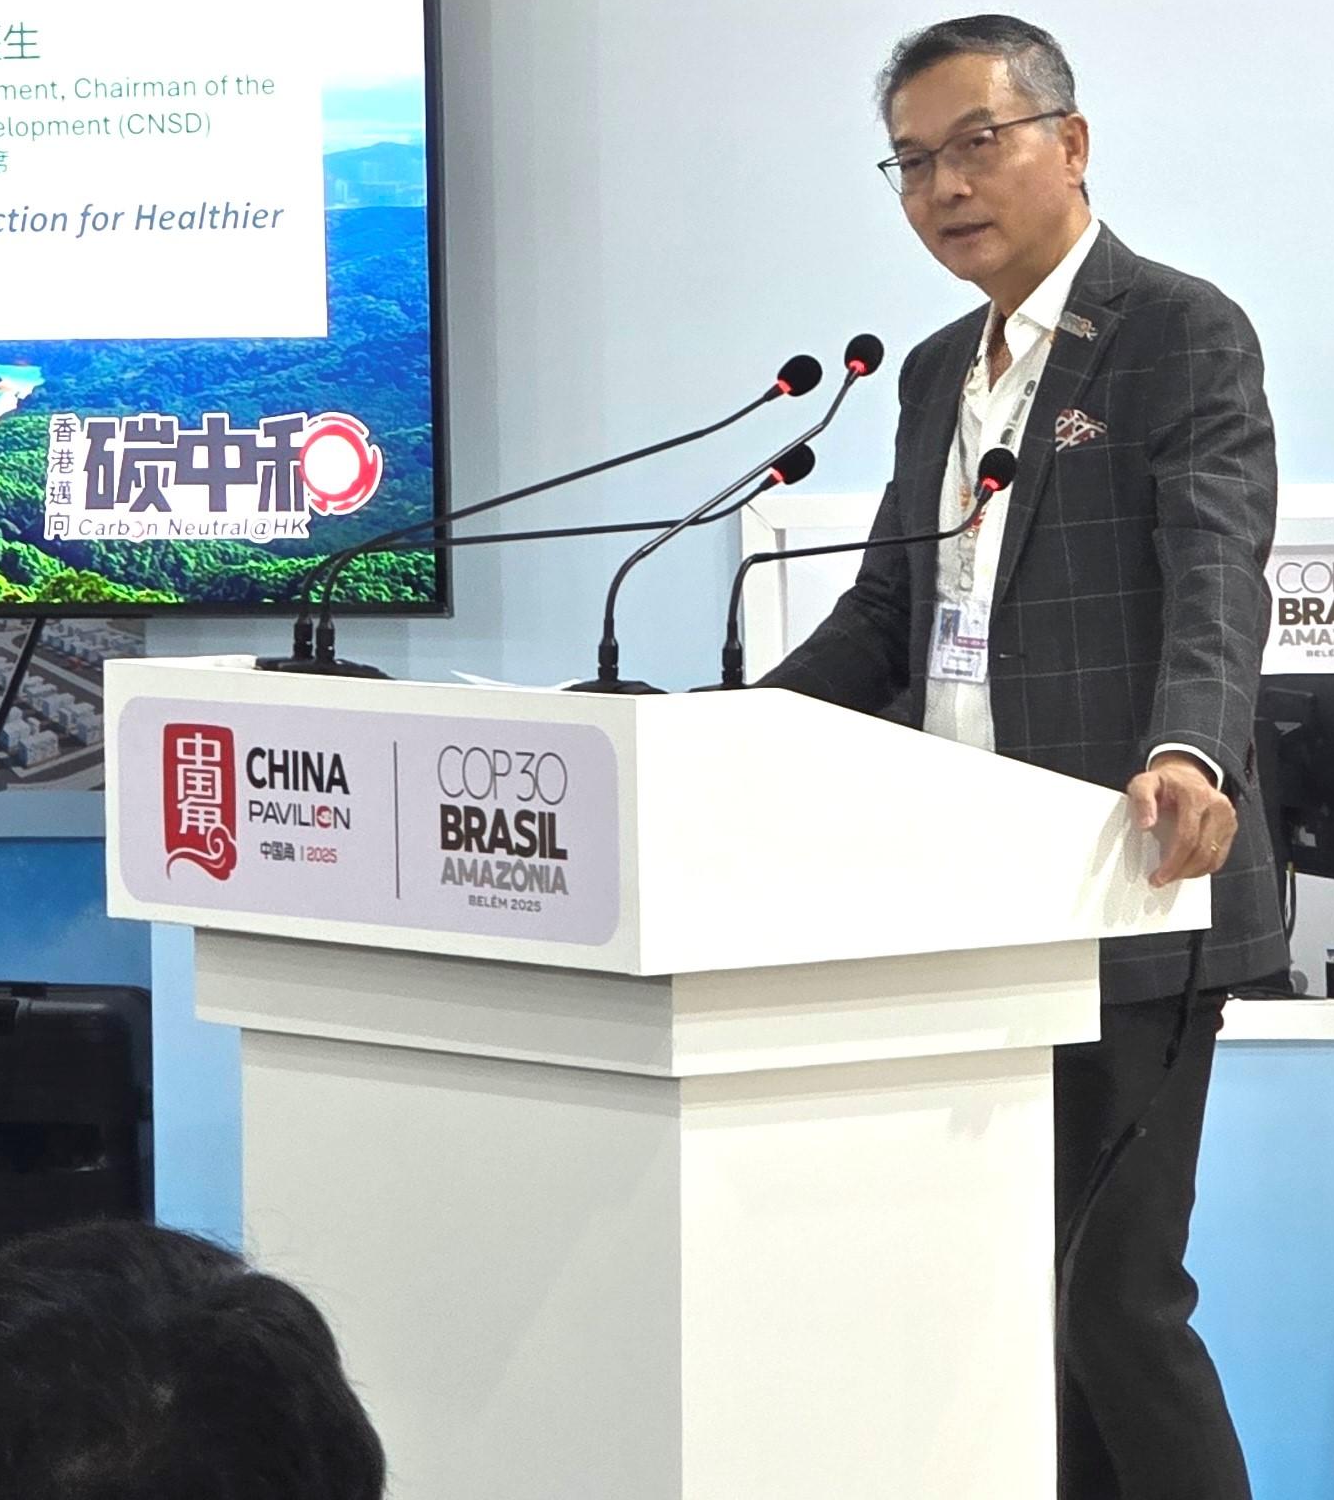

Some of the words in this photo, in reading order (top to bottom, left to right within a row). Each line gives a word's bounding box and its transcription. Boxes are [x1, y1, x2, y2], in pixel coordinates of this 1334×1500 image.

[74, 76, 196, 100] Chairman
[205, 75, 228, 96] of
[235, 75, 275, 96] the
[118, 113, 212, 139] (CNSD)
[75, 203, 125, 239] for
[135, 201, 284, 231] Healthier
[246, 746, 351, 796] CHINA
[437, 745, 568, 806] COP30
[249, 799, 351, 831] PAVILION
[440, 803, 569, 861] BRASIL
[260, 841, 295, 863] 中国角
[306, 846, 338, 864] 2025
[441, 854, 569, 896] AMAZÔNIA
[468, 893, 508, 912] BELÉM
[510, 898, 542, 913] 2025
